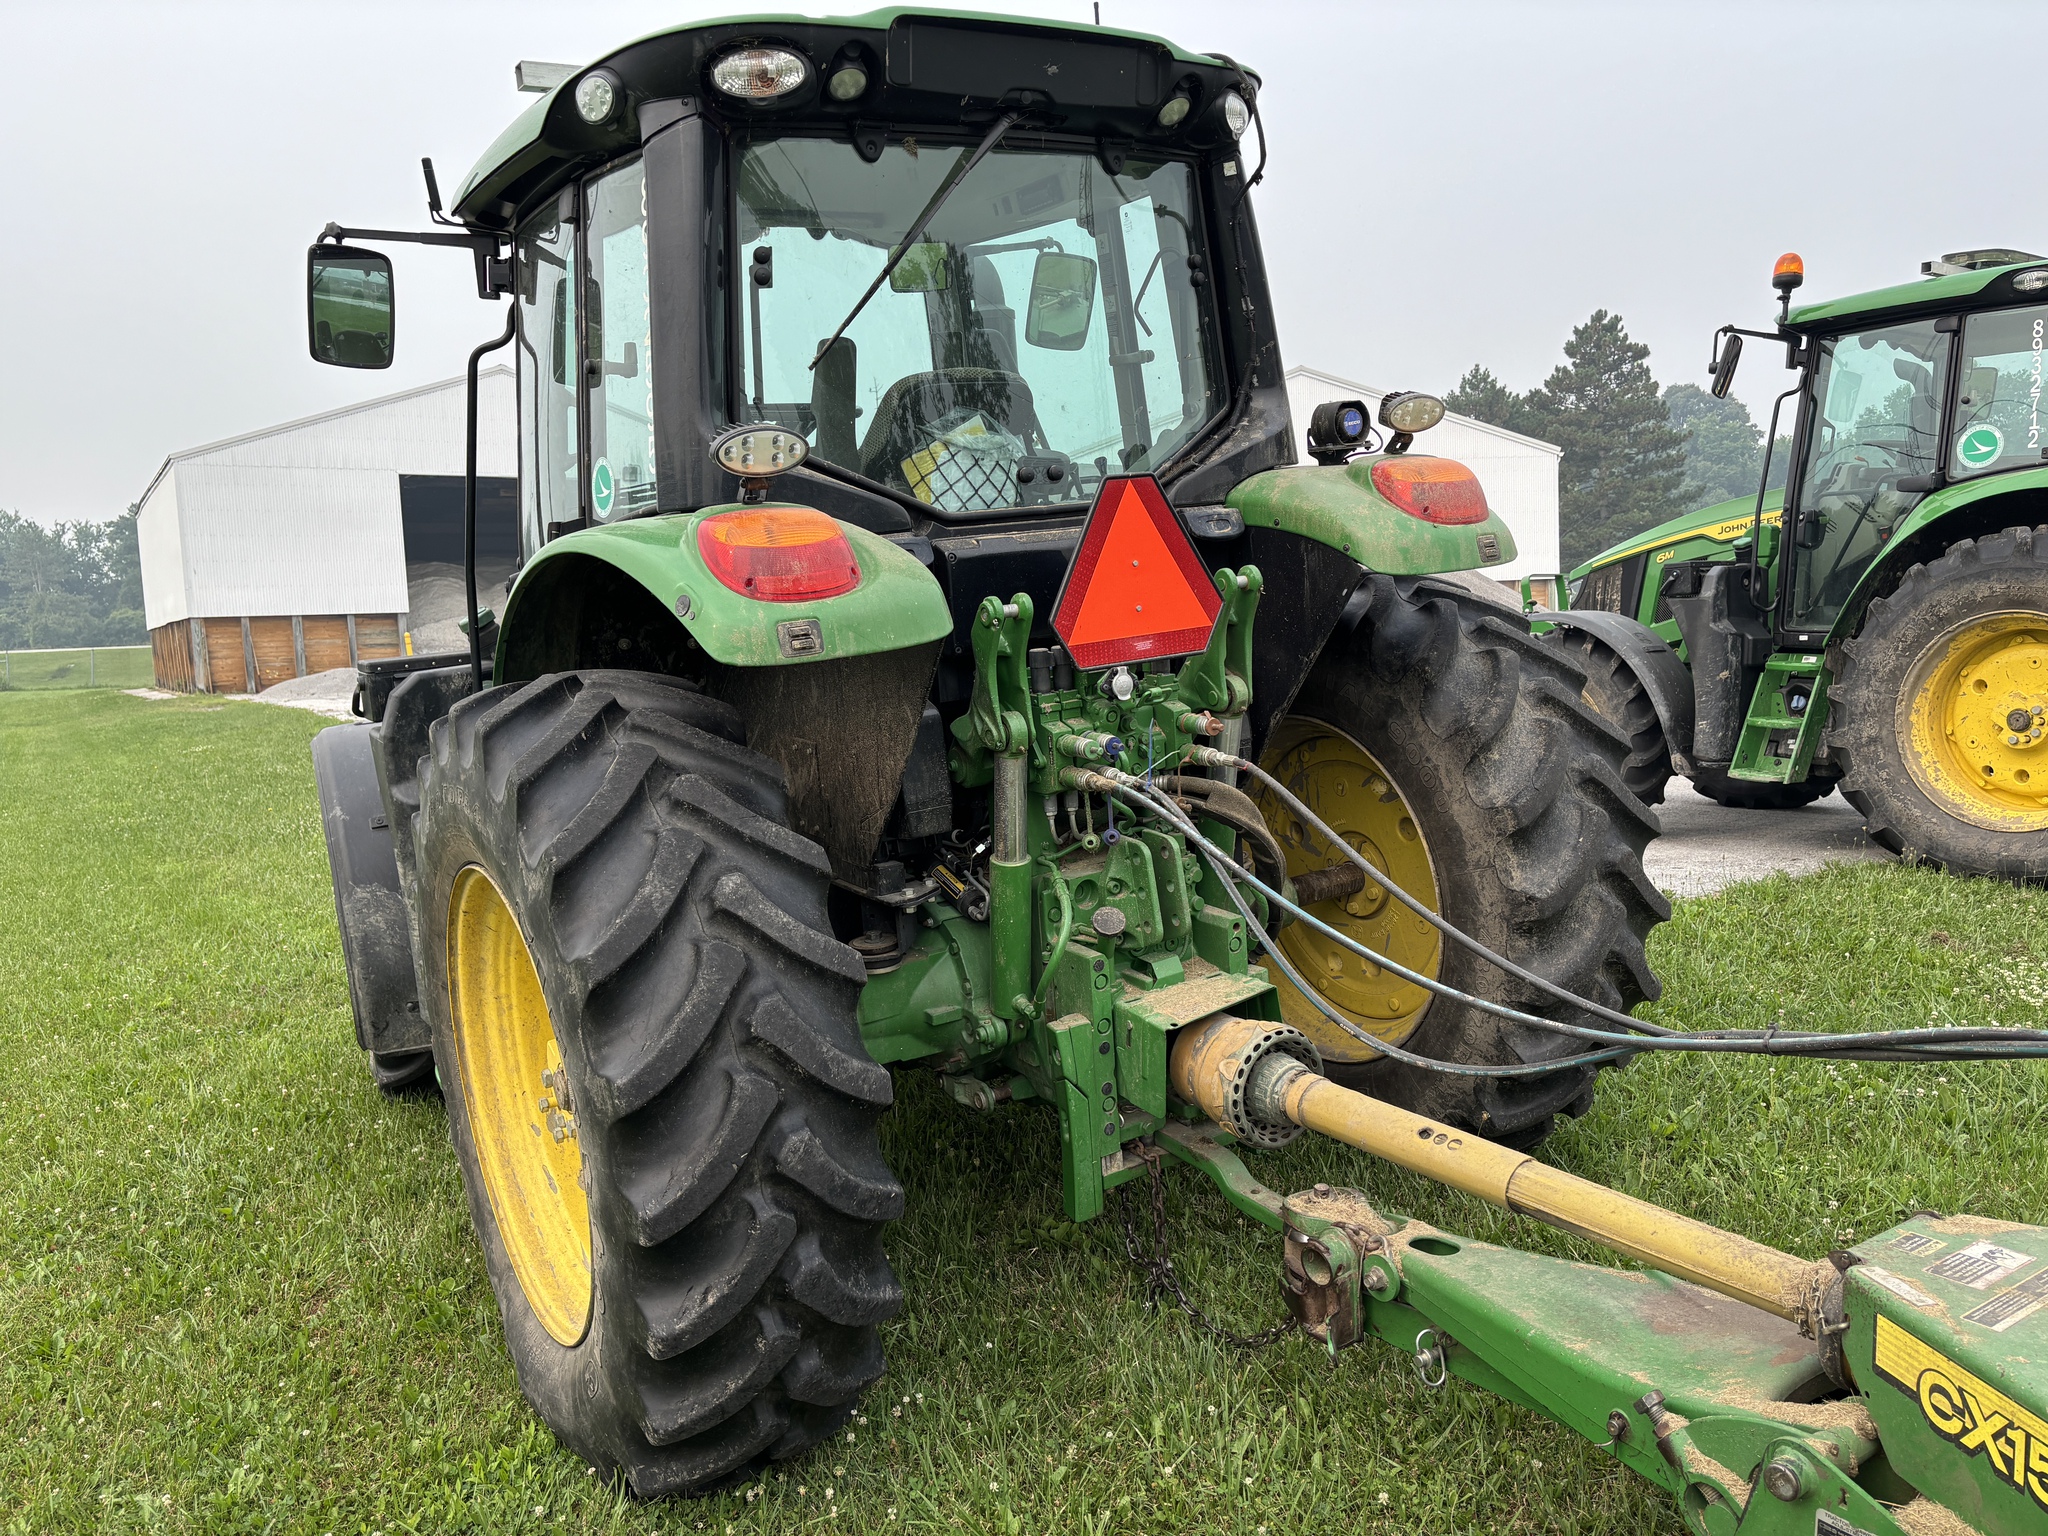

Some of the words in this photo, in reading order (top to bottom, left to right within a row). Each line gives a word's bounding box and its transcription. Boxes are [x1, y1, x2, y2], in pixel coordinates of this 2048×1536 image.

[1717, 522, 1748, 535] JOHN
[1656, 549, 1675, 564] 6M
[1387, 721, 1451, 814] 9000
